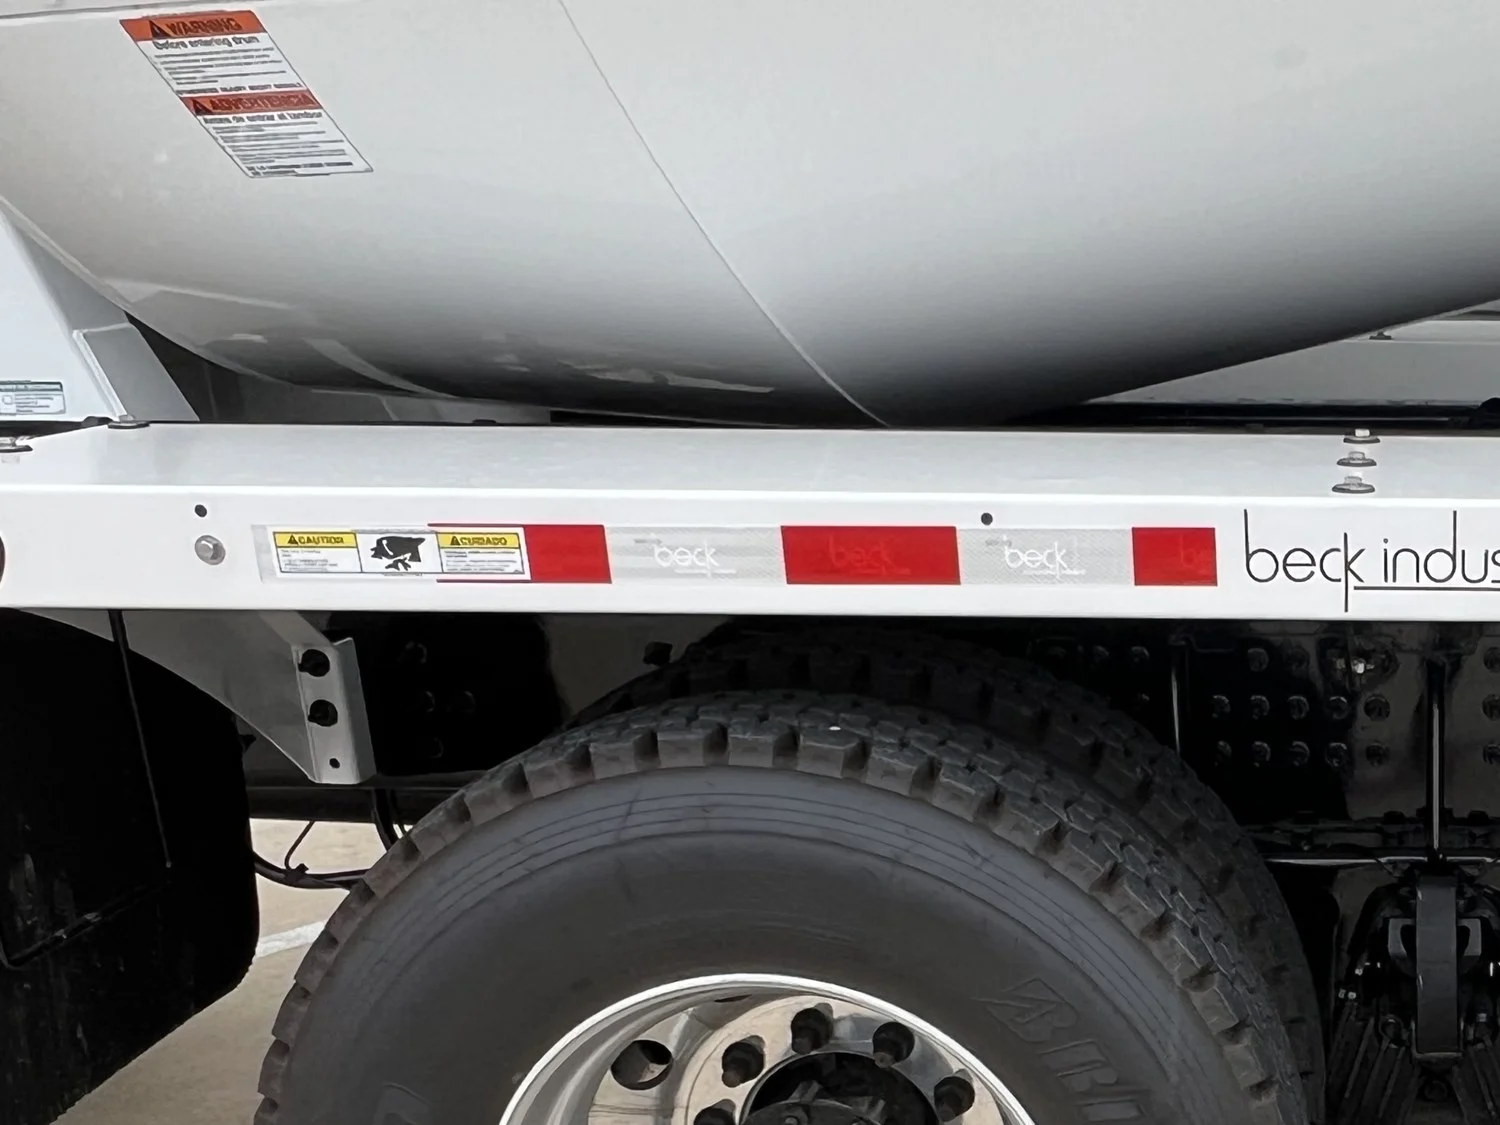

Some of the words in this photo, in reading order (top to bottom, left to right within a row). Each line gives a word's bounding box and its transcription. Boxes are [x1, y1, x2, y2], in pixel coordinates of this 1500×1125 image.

[165, 17, 243, 35] WARNING
[231, 36, 260, 45] drum
[210, 93, 317, 111] ADVERTENCIA
[298, 536, 345, 545] CAUTION
[459, 536, 508, 546] CUIDADO
[652, 534, 720, 577] beck
[1002, 534, 1070, 580] beck
[1244, 508, 1365, 613] beck
